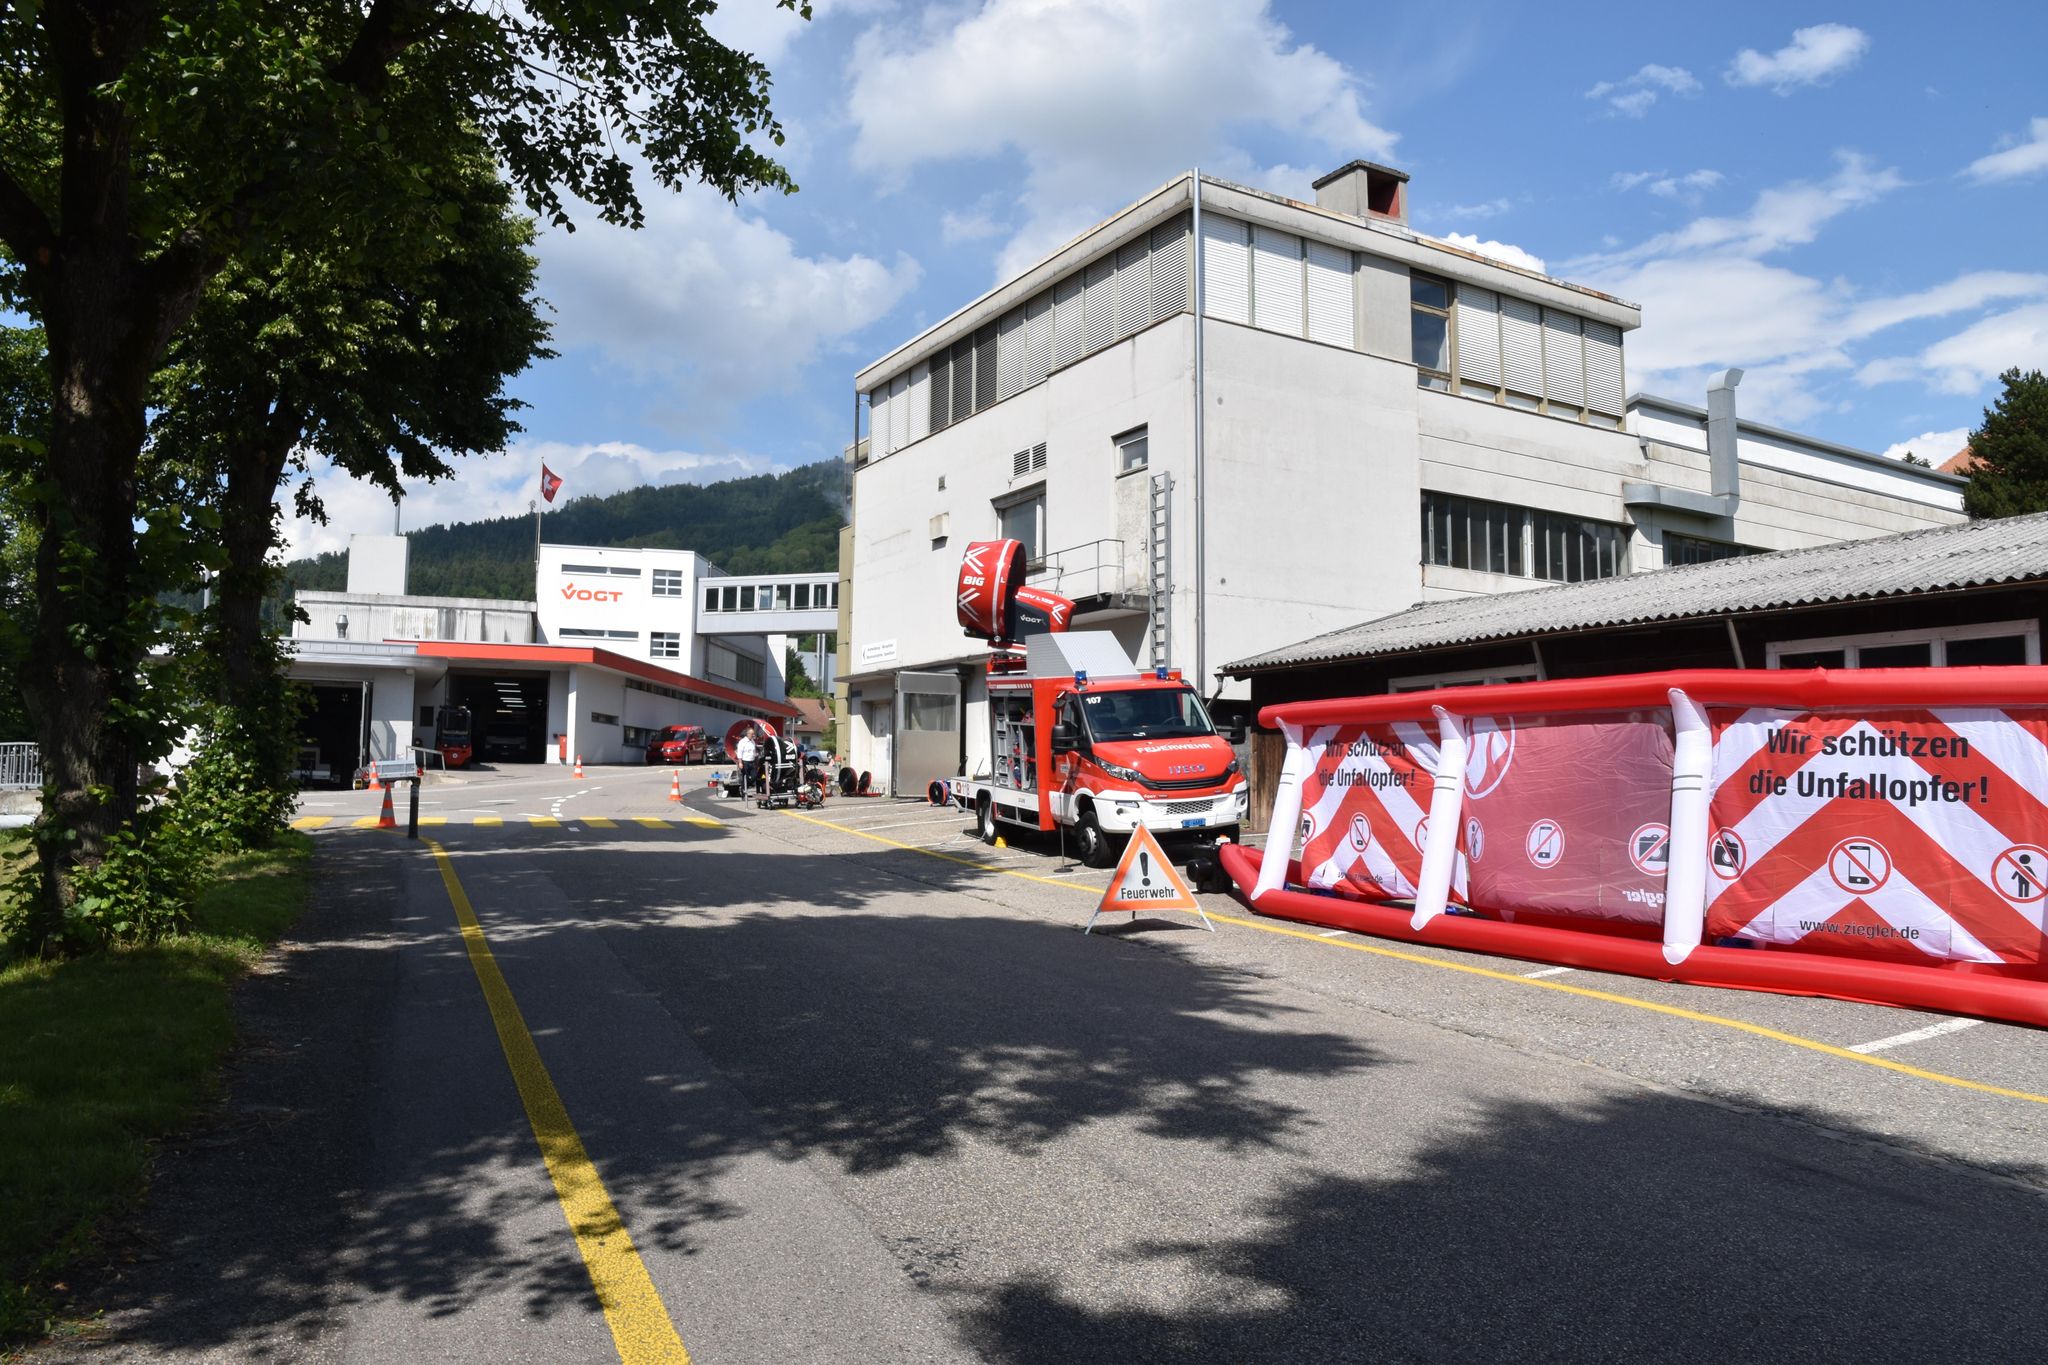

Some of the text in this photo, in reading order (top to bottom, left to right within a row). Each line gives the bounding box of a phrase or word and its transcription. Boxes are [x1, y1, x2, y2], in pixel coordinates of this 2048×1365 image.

[963, 575, 985, 586] BIG
[561, 582, 623, 602] VOGT
[1020, 614, 1041, 624] VOGT
[1086, 696, 1101, 705] 107
[1136, 743, 1213, 754] FEUERWEHR
[1325, 739, 1406, 758] Wir schützen
[1767, 728, 1969, 758] Wir schützen
[1168, 764, 1206, 775] IVECO
[1319, 768, 1416, 791] die Unfallopfer!
[1749, 769, 1988, 807] die Unfallopfer!
[1121, 886, 1175, 900] Feuerwehr
[1799, 918, 1920, 940] www.ziegler.de
